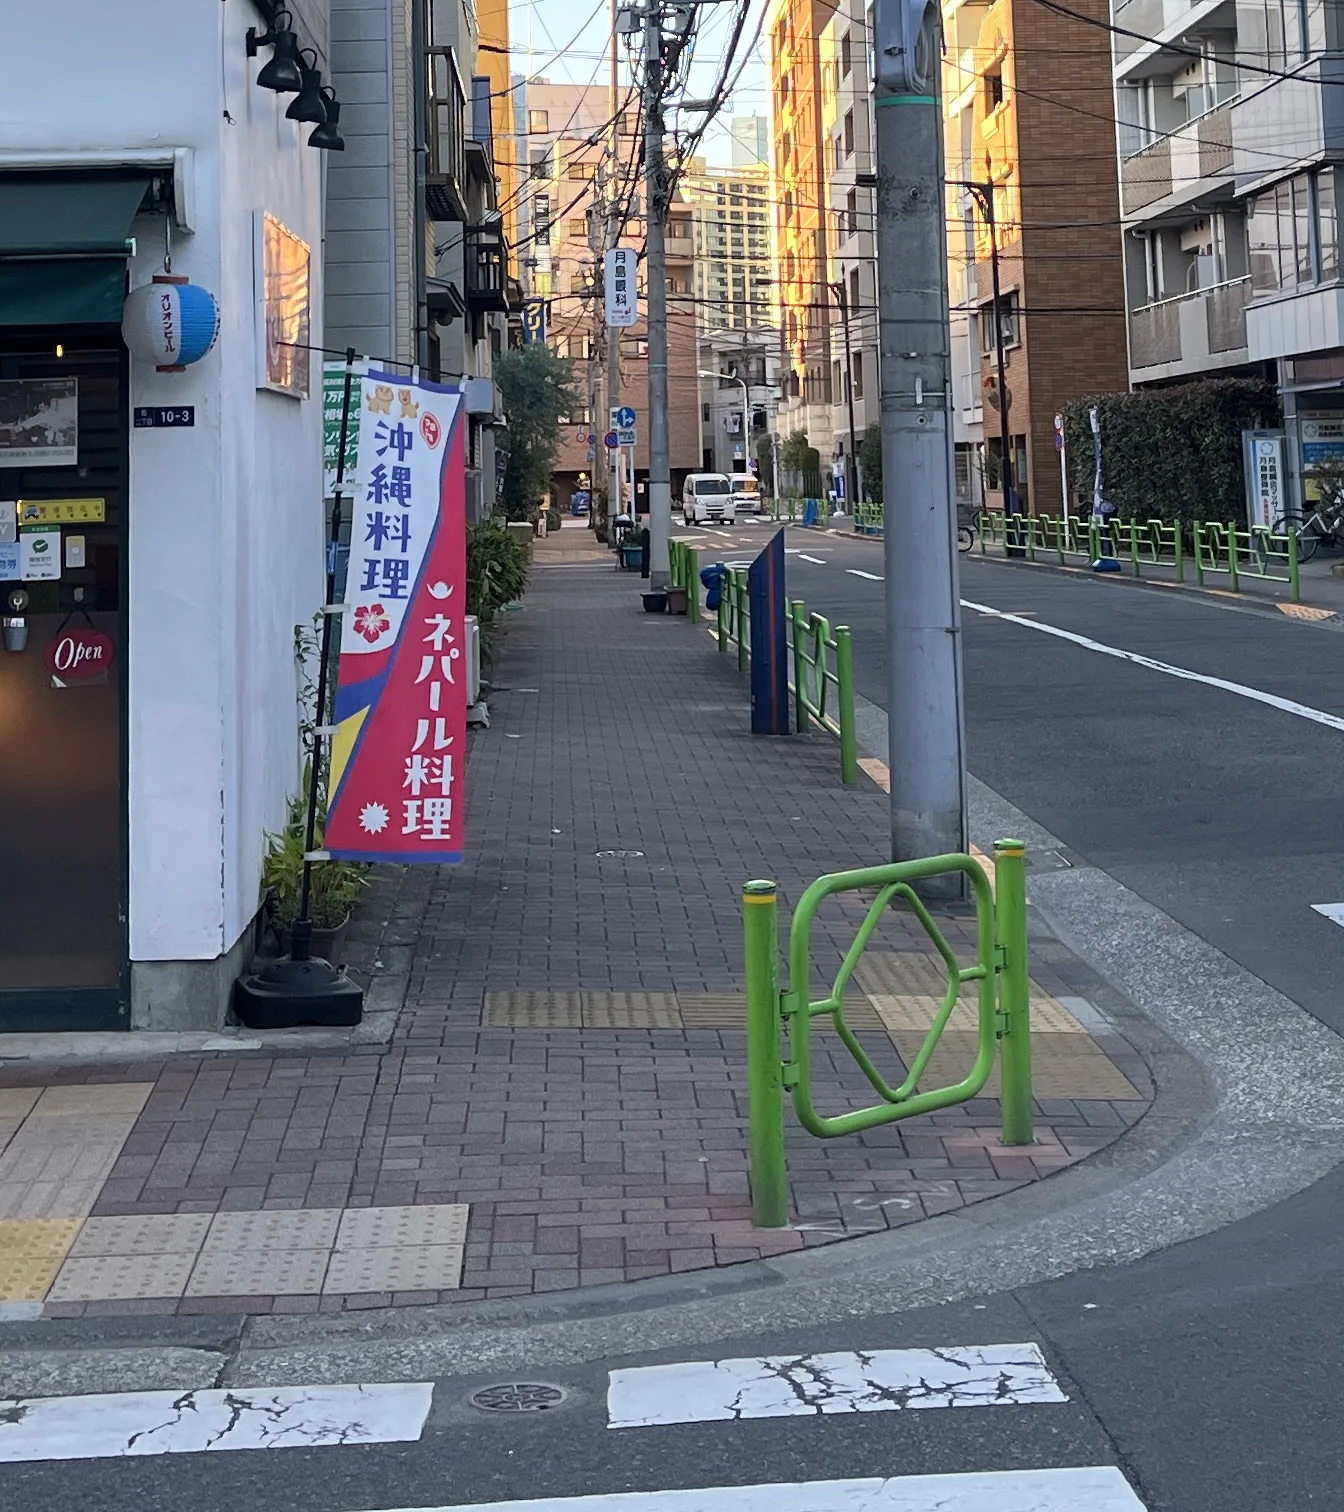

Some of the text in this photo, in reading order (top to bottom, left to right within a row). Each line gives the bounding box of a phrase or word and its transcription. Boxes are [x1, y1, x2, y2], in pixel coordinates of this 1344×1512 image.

[160, 293, 176, 354] オリオンビール
[160, 410, 190, 423] 10-3
[360, 420, 414, 600] 沖縄料理
[54, 637, 103, 671] Open
[401, 612, 460, 841] ネパール料理
